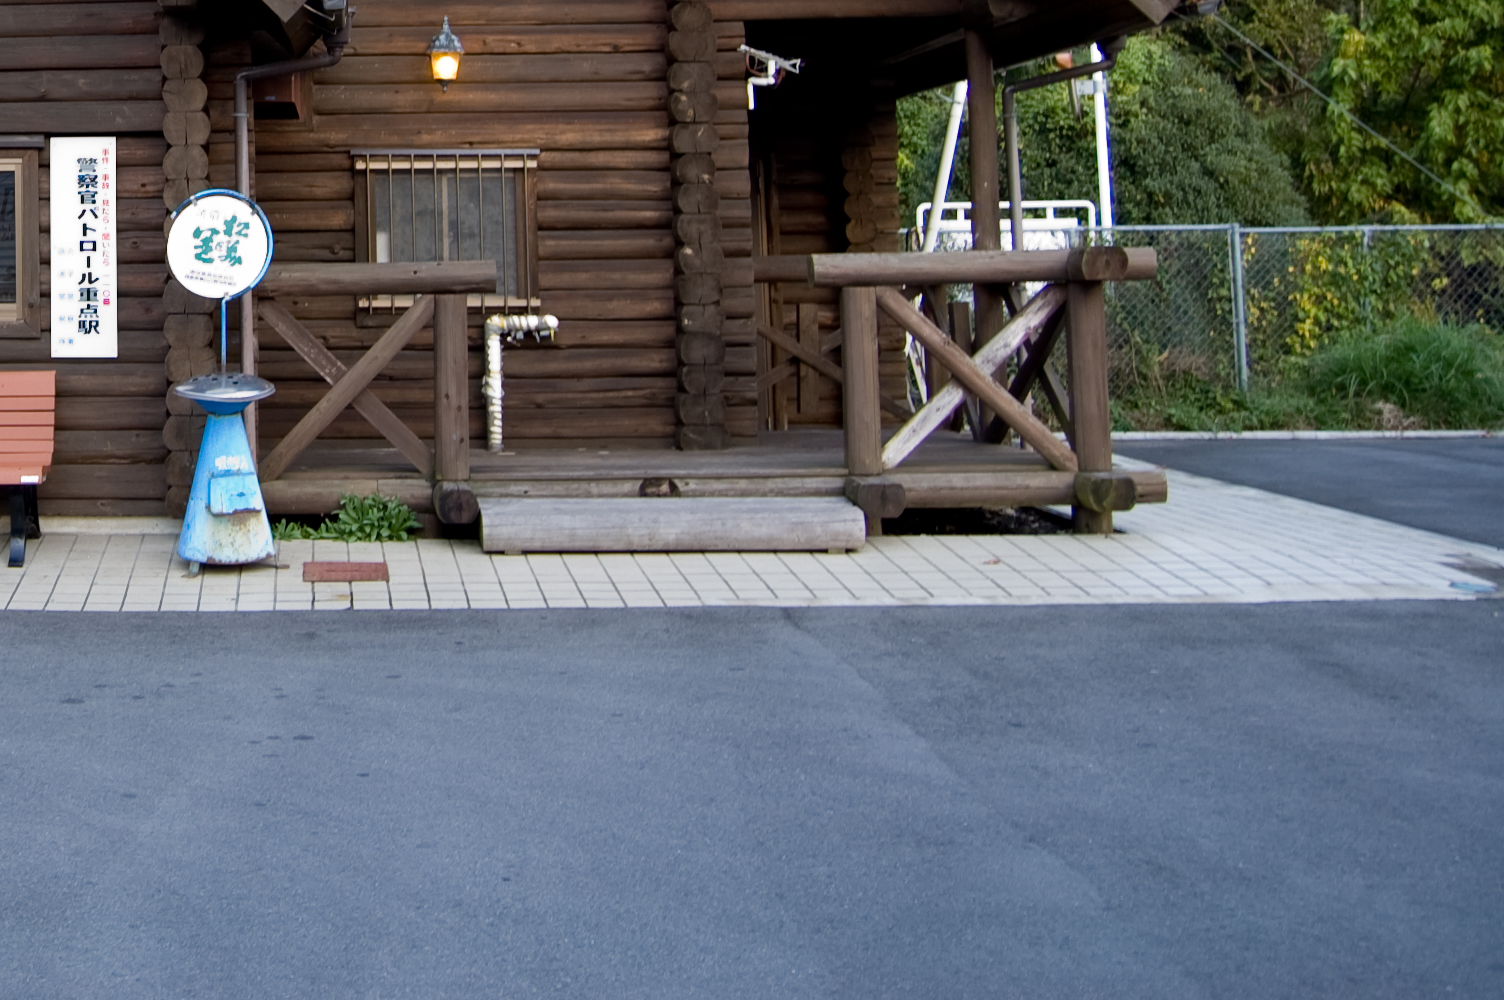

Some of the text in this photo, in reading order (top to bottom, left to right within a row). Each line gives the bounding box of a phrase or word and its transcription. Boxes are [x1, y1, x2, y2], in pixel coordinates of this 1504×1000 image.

[77, 157, 100, 335] 警察官パトロール重点駅
